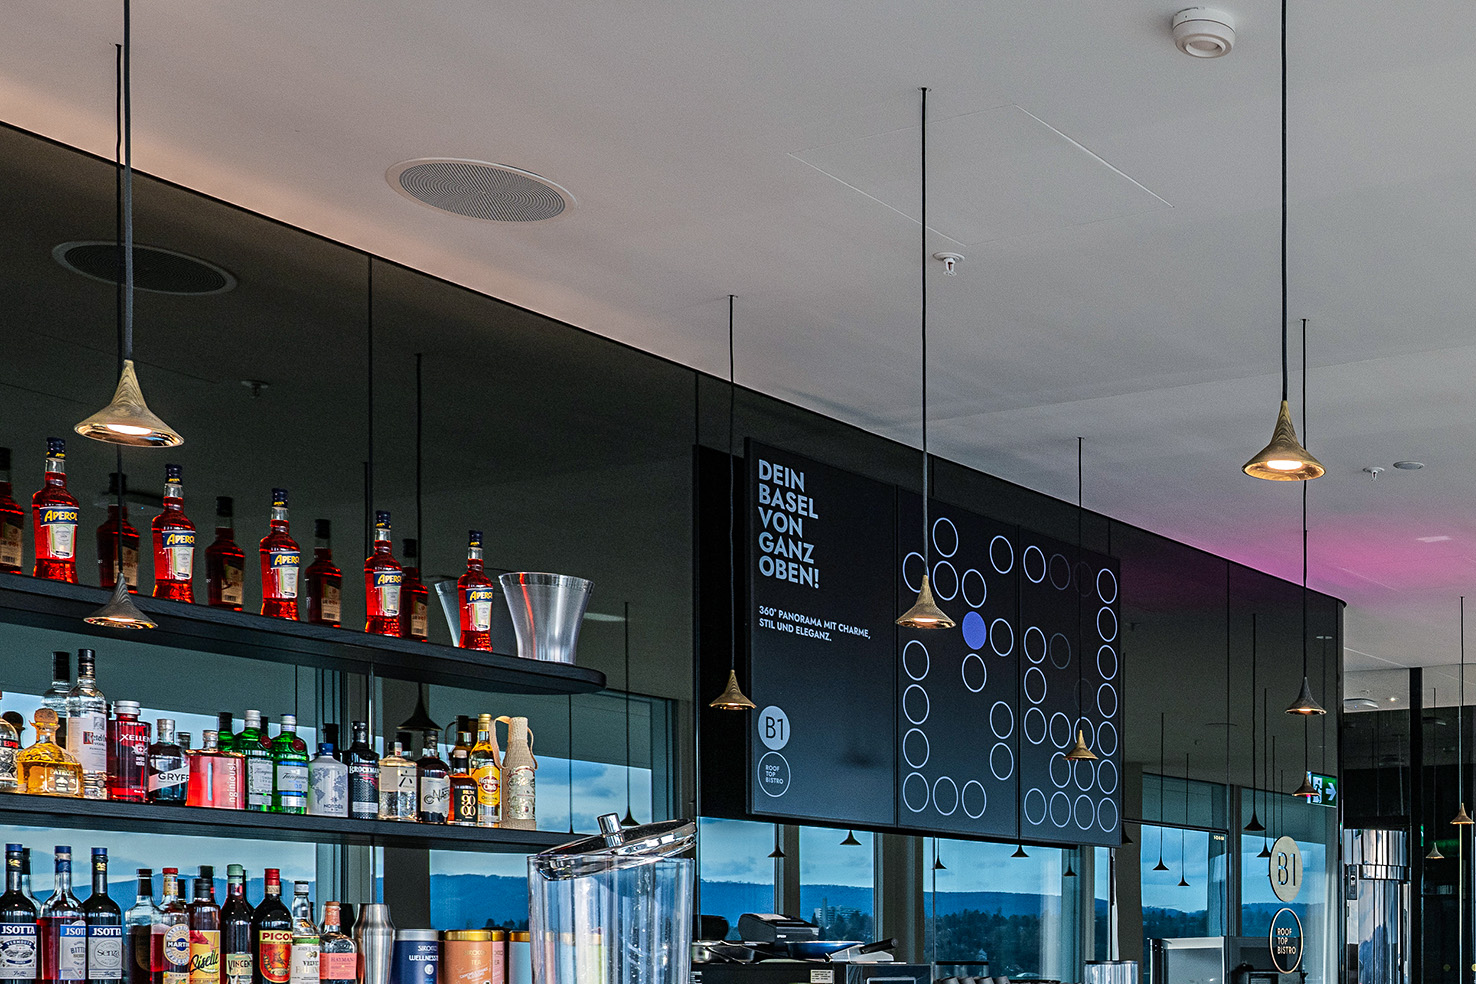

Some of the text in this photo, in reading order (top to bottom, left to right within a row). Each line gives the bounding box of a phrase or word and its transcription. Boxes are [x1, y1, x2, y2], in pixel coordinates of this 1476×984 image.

[758, 458, 805, 493] DEIN
[758, 482, 819, 520] BASEL
[757, 506, 803, 539] VON
[166, 533, 195, 545] APERO
[758, 531, 815, 564] GANZ
[274, 554, 300, 566] APERO
[377, 574, 402, 585] APERO
[758, 555, 820, 589] OBEN!
[469, 591, 493, 601] APERO
[759, 605, 871, 640] 360° PANORAMA MIT CHARME,
[759, 617, 832, 641] STIL UND ELEGANZ.
[765, 716, 784, 741] B1
[765, 764, 780, 772] ROOF
[765, 777, 784, 785] BISTRO
[1277, 852, 1296, 886] B1
[1276, 927, 1293, 936] ROOF
[1276, 937, 1288, 945] TOP
[1276, 946, 1297, 955] BISTRO
